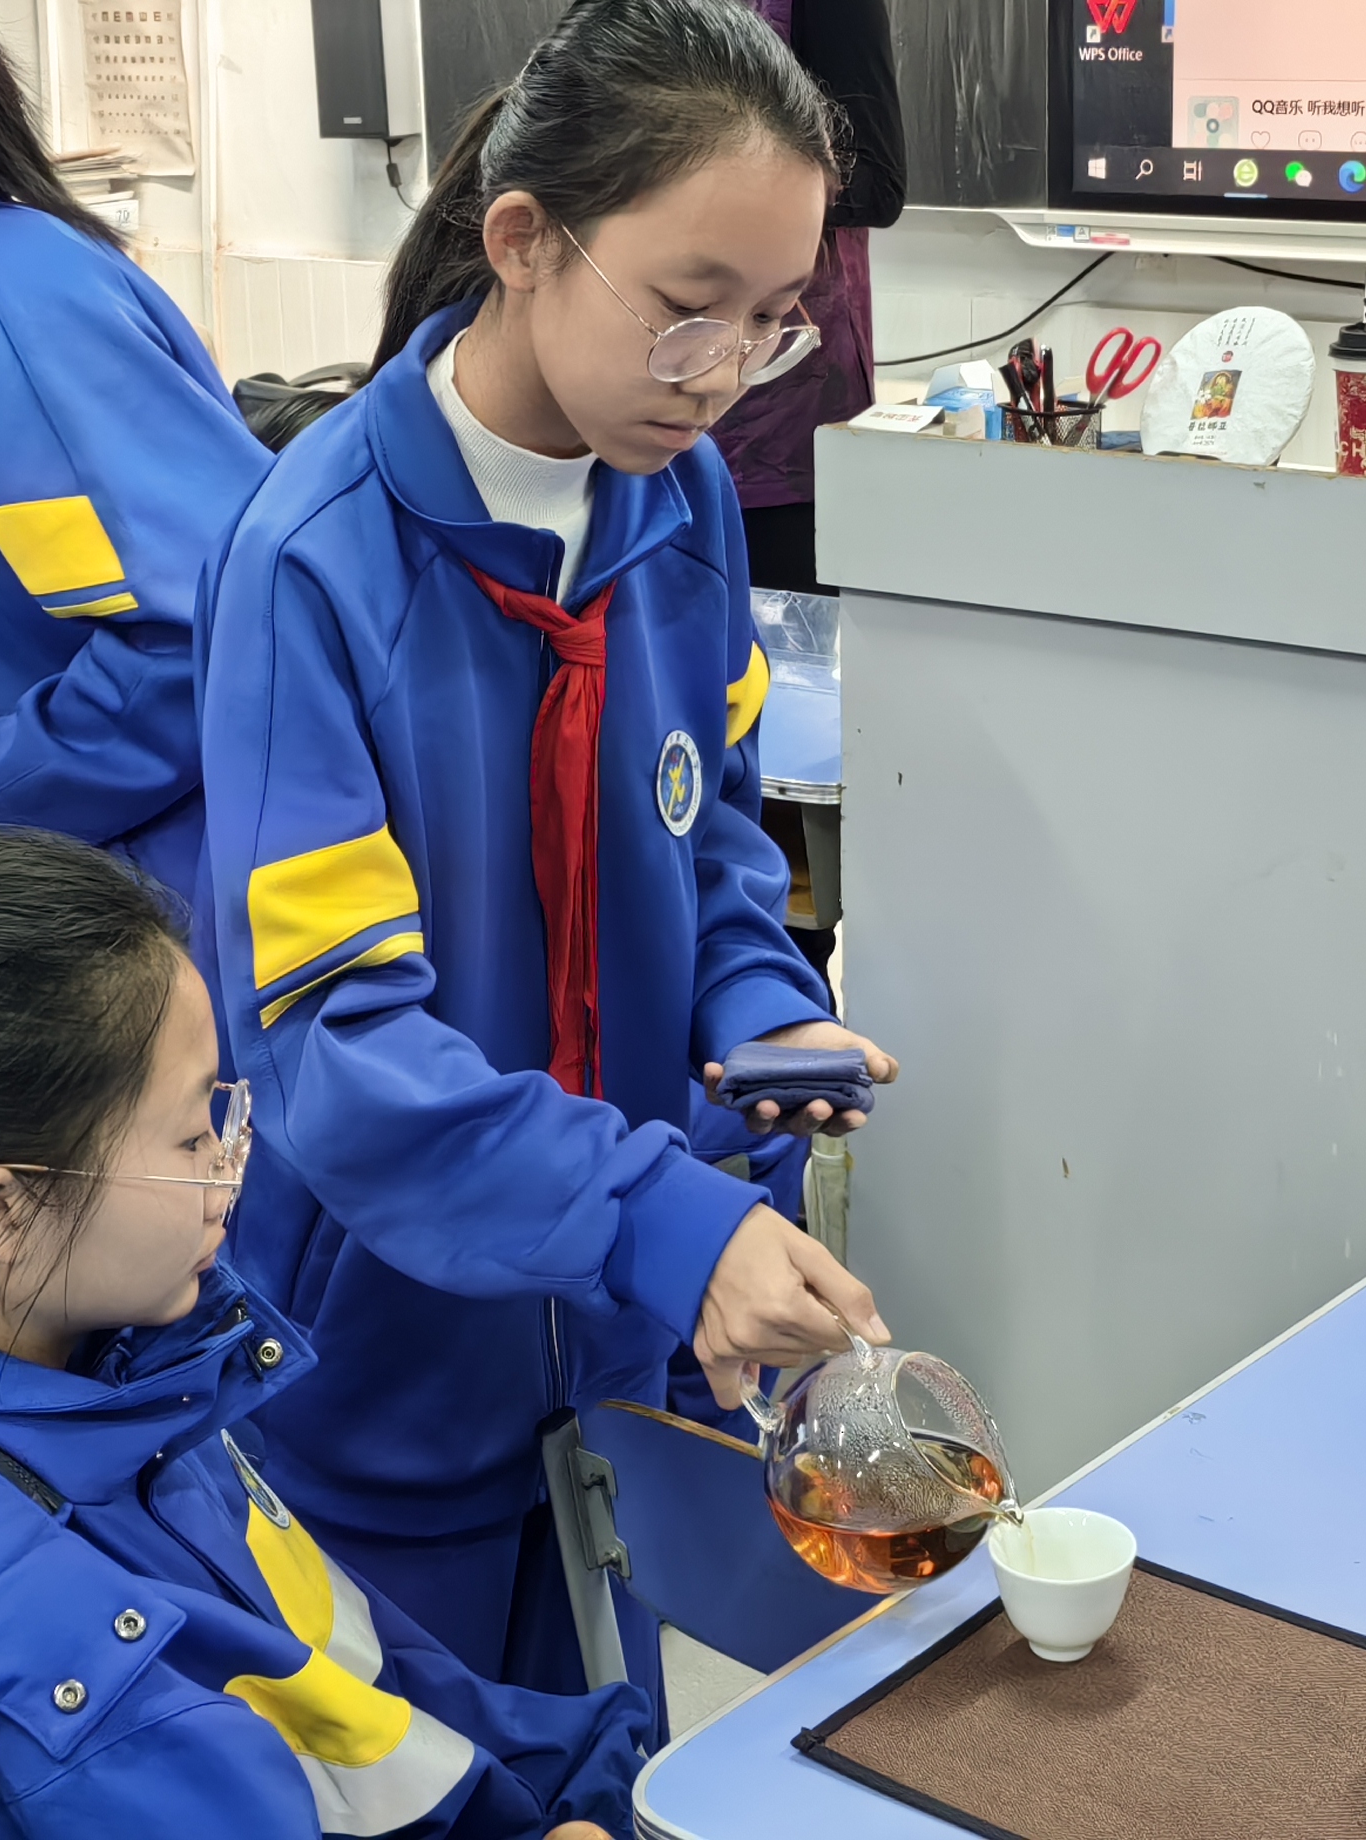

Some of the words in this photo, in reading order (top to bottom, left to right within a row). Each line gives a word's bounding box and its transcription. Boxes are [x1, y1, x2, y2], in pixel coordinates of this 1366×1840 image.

[1078, 47, 1106, 61] WPS
[1107, 46, 1144, 62] Office
[1251, 98, 1304, 116] QQ音乐
[1306, 98, 1366, 117] 听我想听
